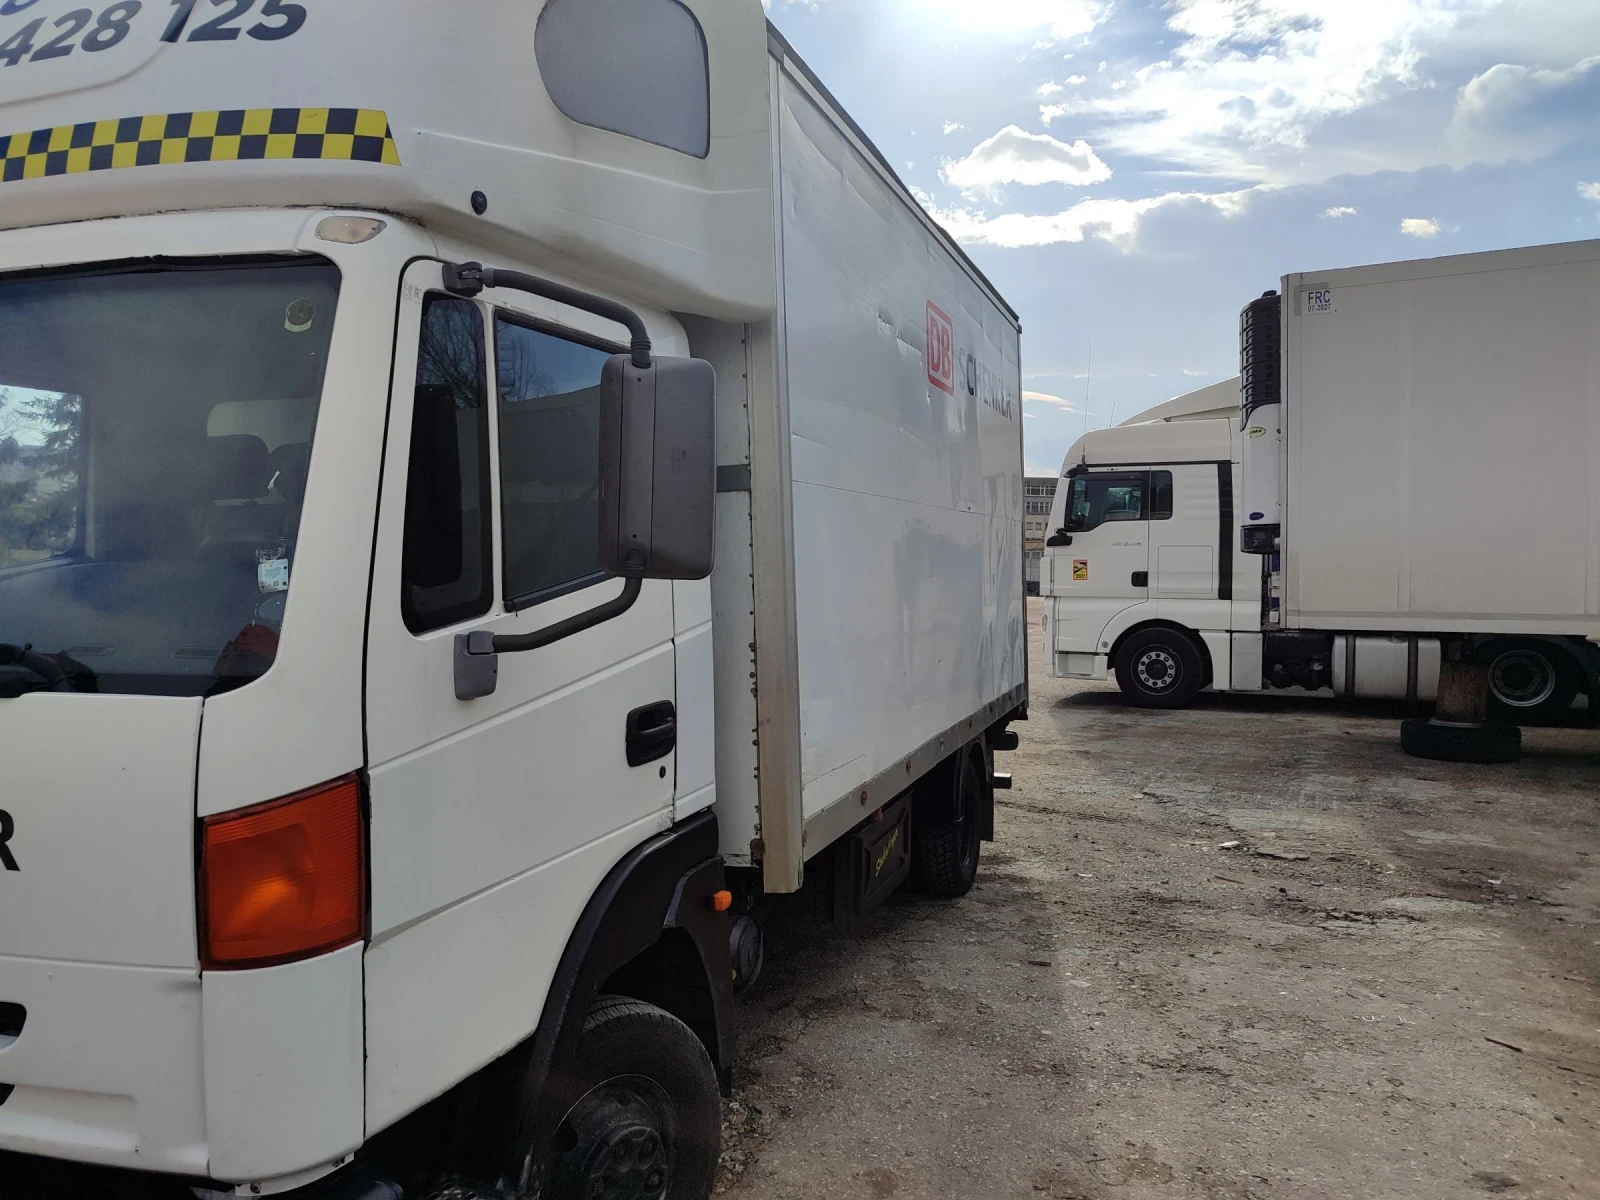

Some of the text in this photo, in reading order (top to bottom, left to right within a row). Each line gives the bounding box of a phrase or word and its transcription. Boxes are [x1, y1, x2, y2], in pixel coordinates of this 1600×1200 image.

[0, 0, 307, 67] 428 125
[1307, 290, 1331, 305] FRC
[1307, 303, 1331, 313] 07-2027
[929, 315, 952, 380] DB
